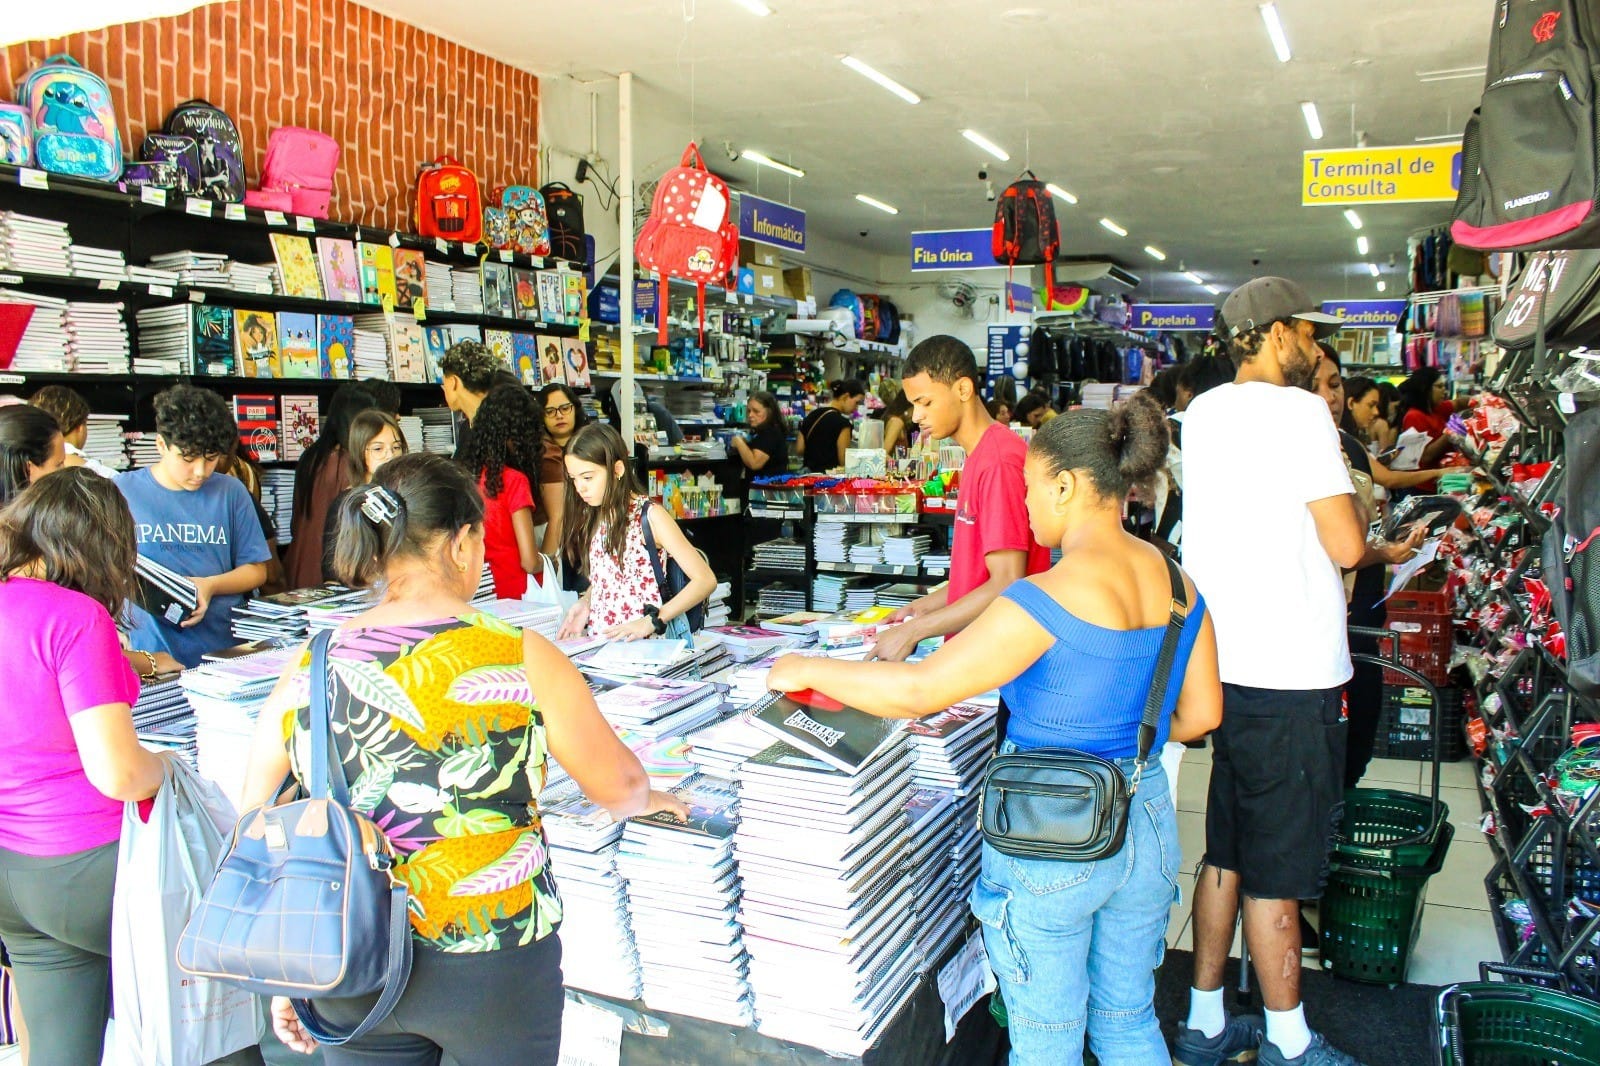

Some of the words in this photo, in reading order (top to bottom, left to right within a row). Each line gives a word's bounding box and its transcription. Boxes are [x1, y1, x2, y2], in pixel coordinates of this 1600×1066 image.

[182, 115, 227, 130] WANDINHA
[1310, 157, 1401, 178] Terminal
[1409, 157, 1435, 174] de
[1308, 178, 1396, 198] Consulta
[1503, 190, 1551, 211] FLAMENGO
[753, 208, 803, 244] Informática
[914, 247, 938, 264] Fila
[940, 247, 973, 262] Única
[1141, 310, 1196, 327] Papelaria
[1336, 307, 1398, 323] Escritório
[248, 407, 265, 415] PARIS
